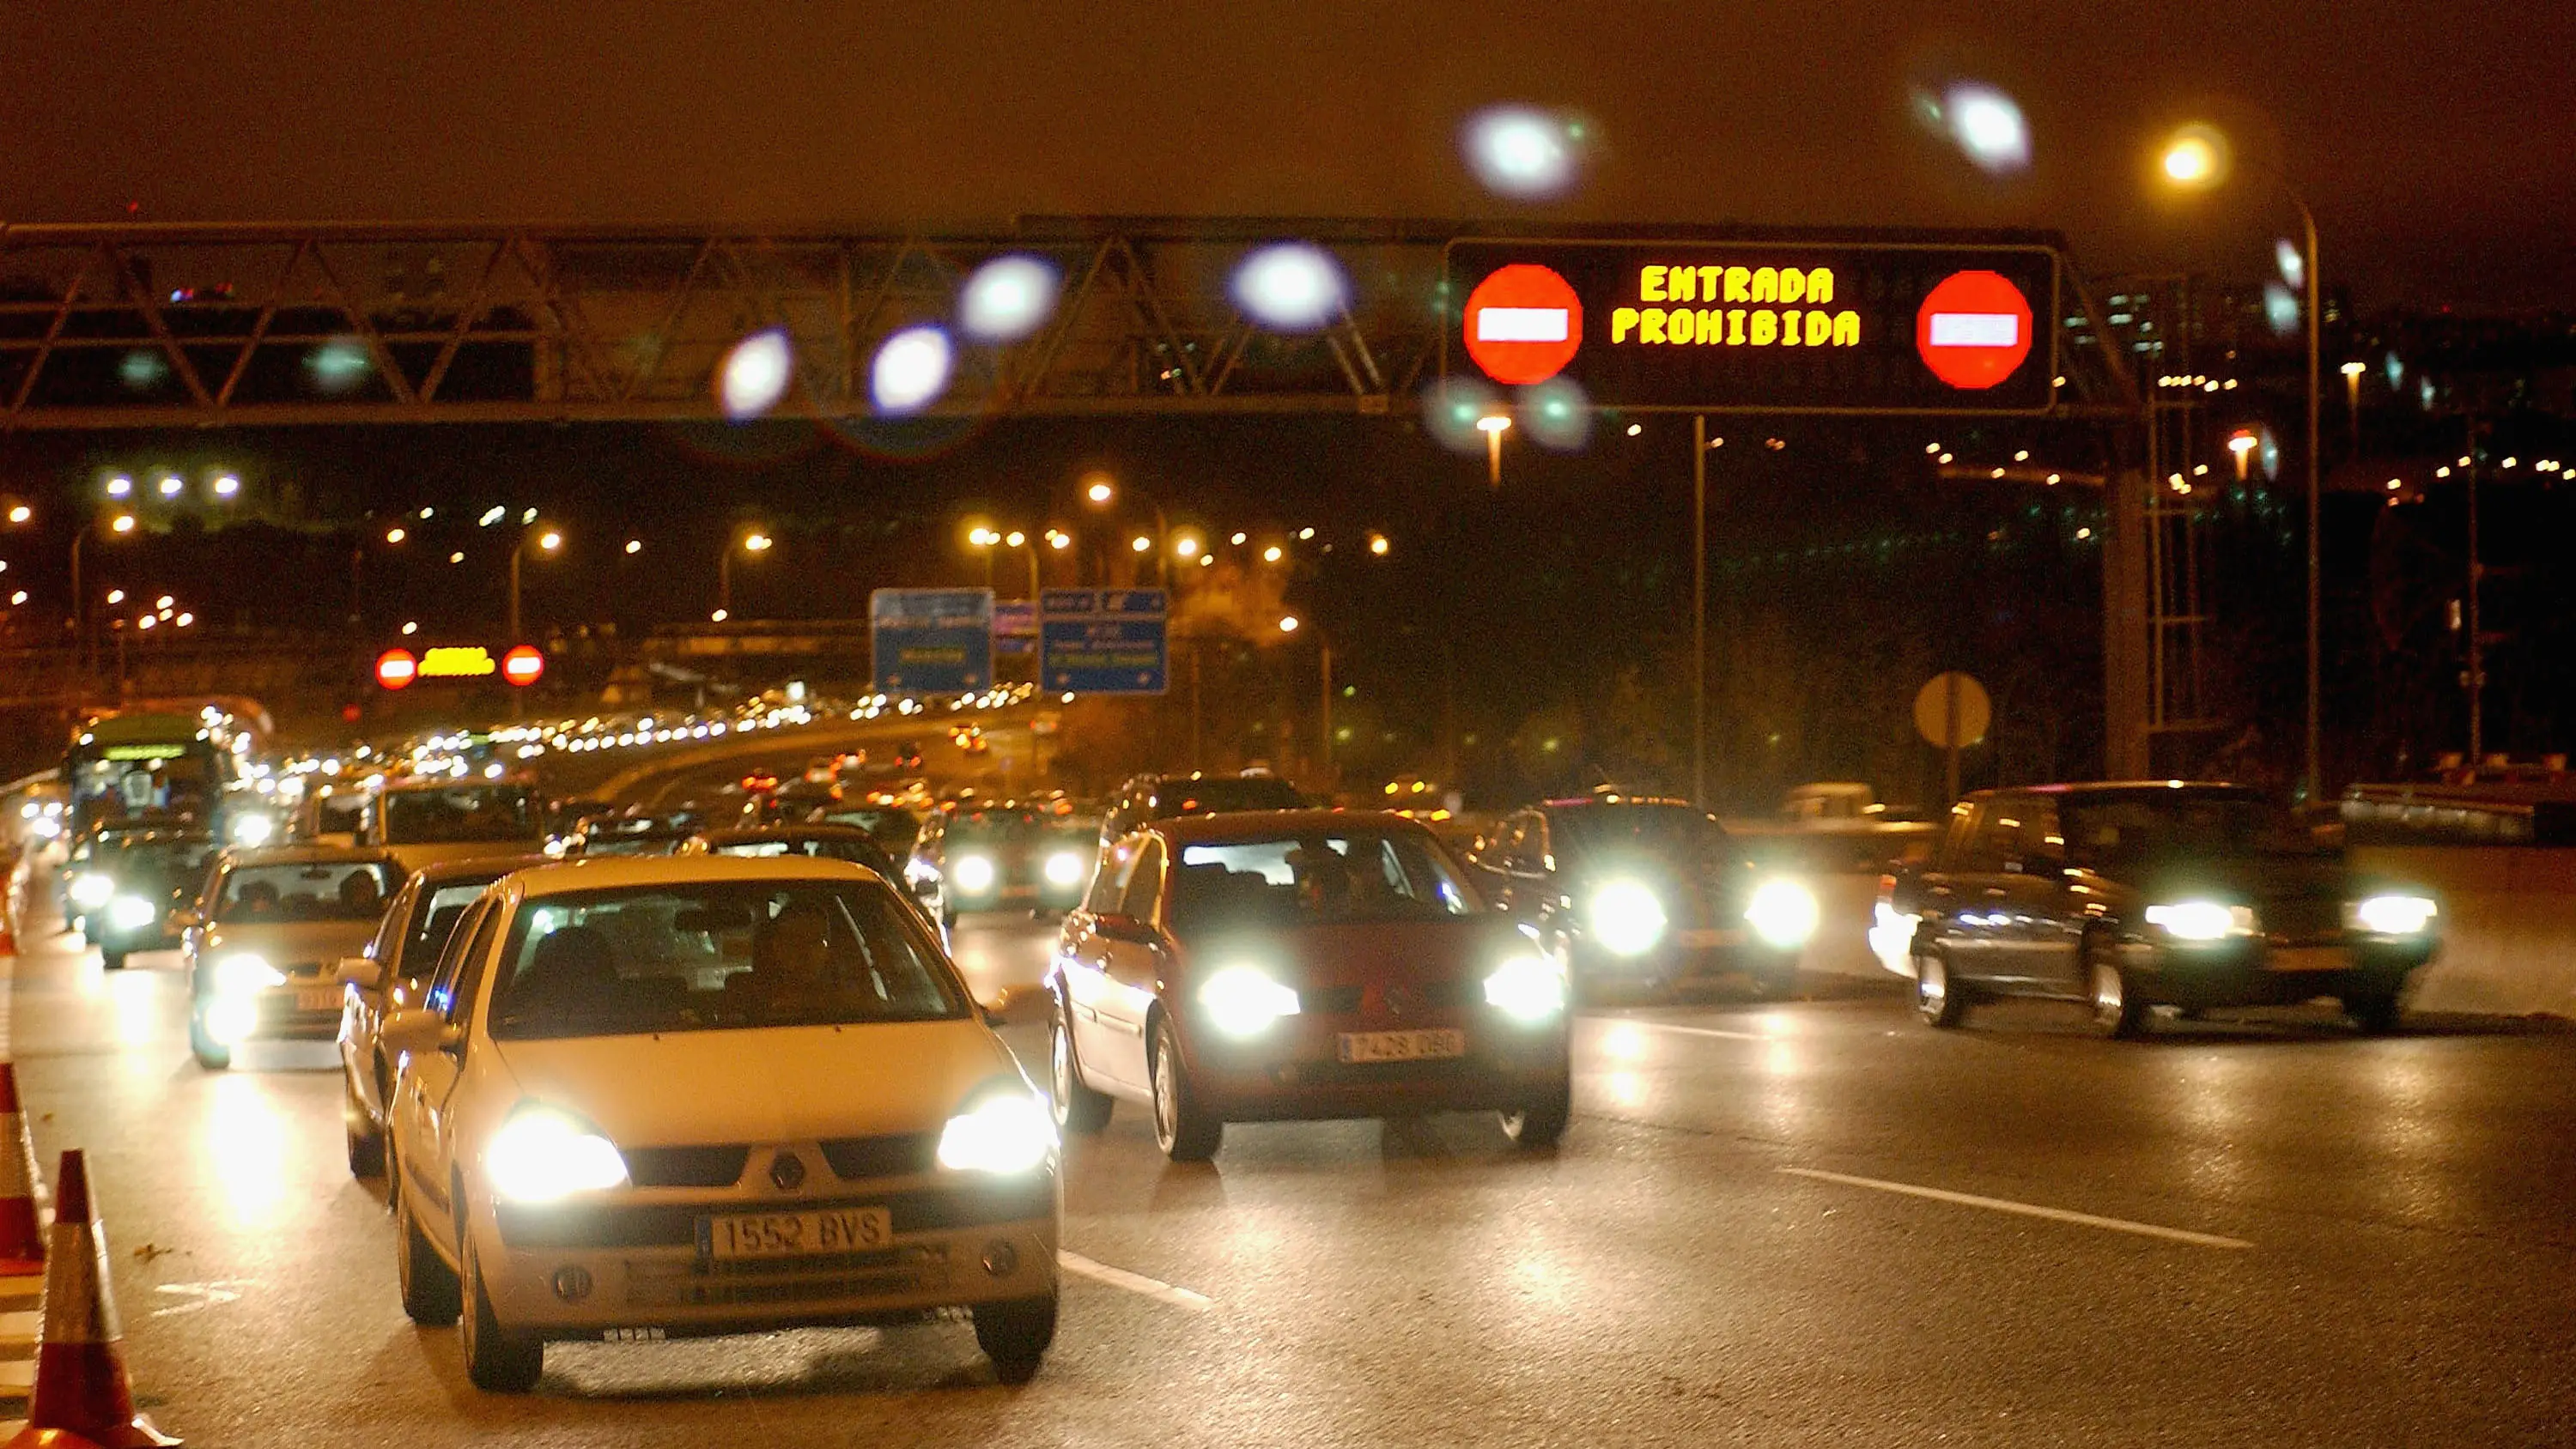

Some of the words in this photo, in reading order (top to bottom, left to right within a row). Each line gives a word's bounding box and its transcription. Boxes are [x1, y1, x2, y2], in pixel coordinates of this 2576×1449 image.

[1640, 265, 1834, 304] ENTRADA
[1612, 307, 1861, 347] PROHIBIDA
[729, 1215, 804, 1255] 1552
[821, 1212, 880, 1246] BVS
